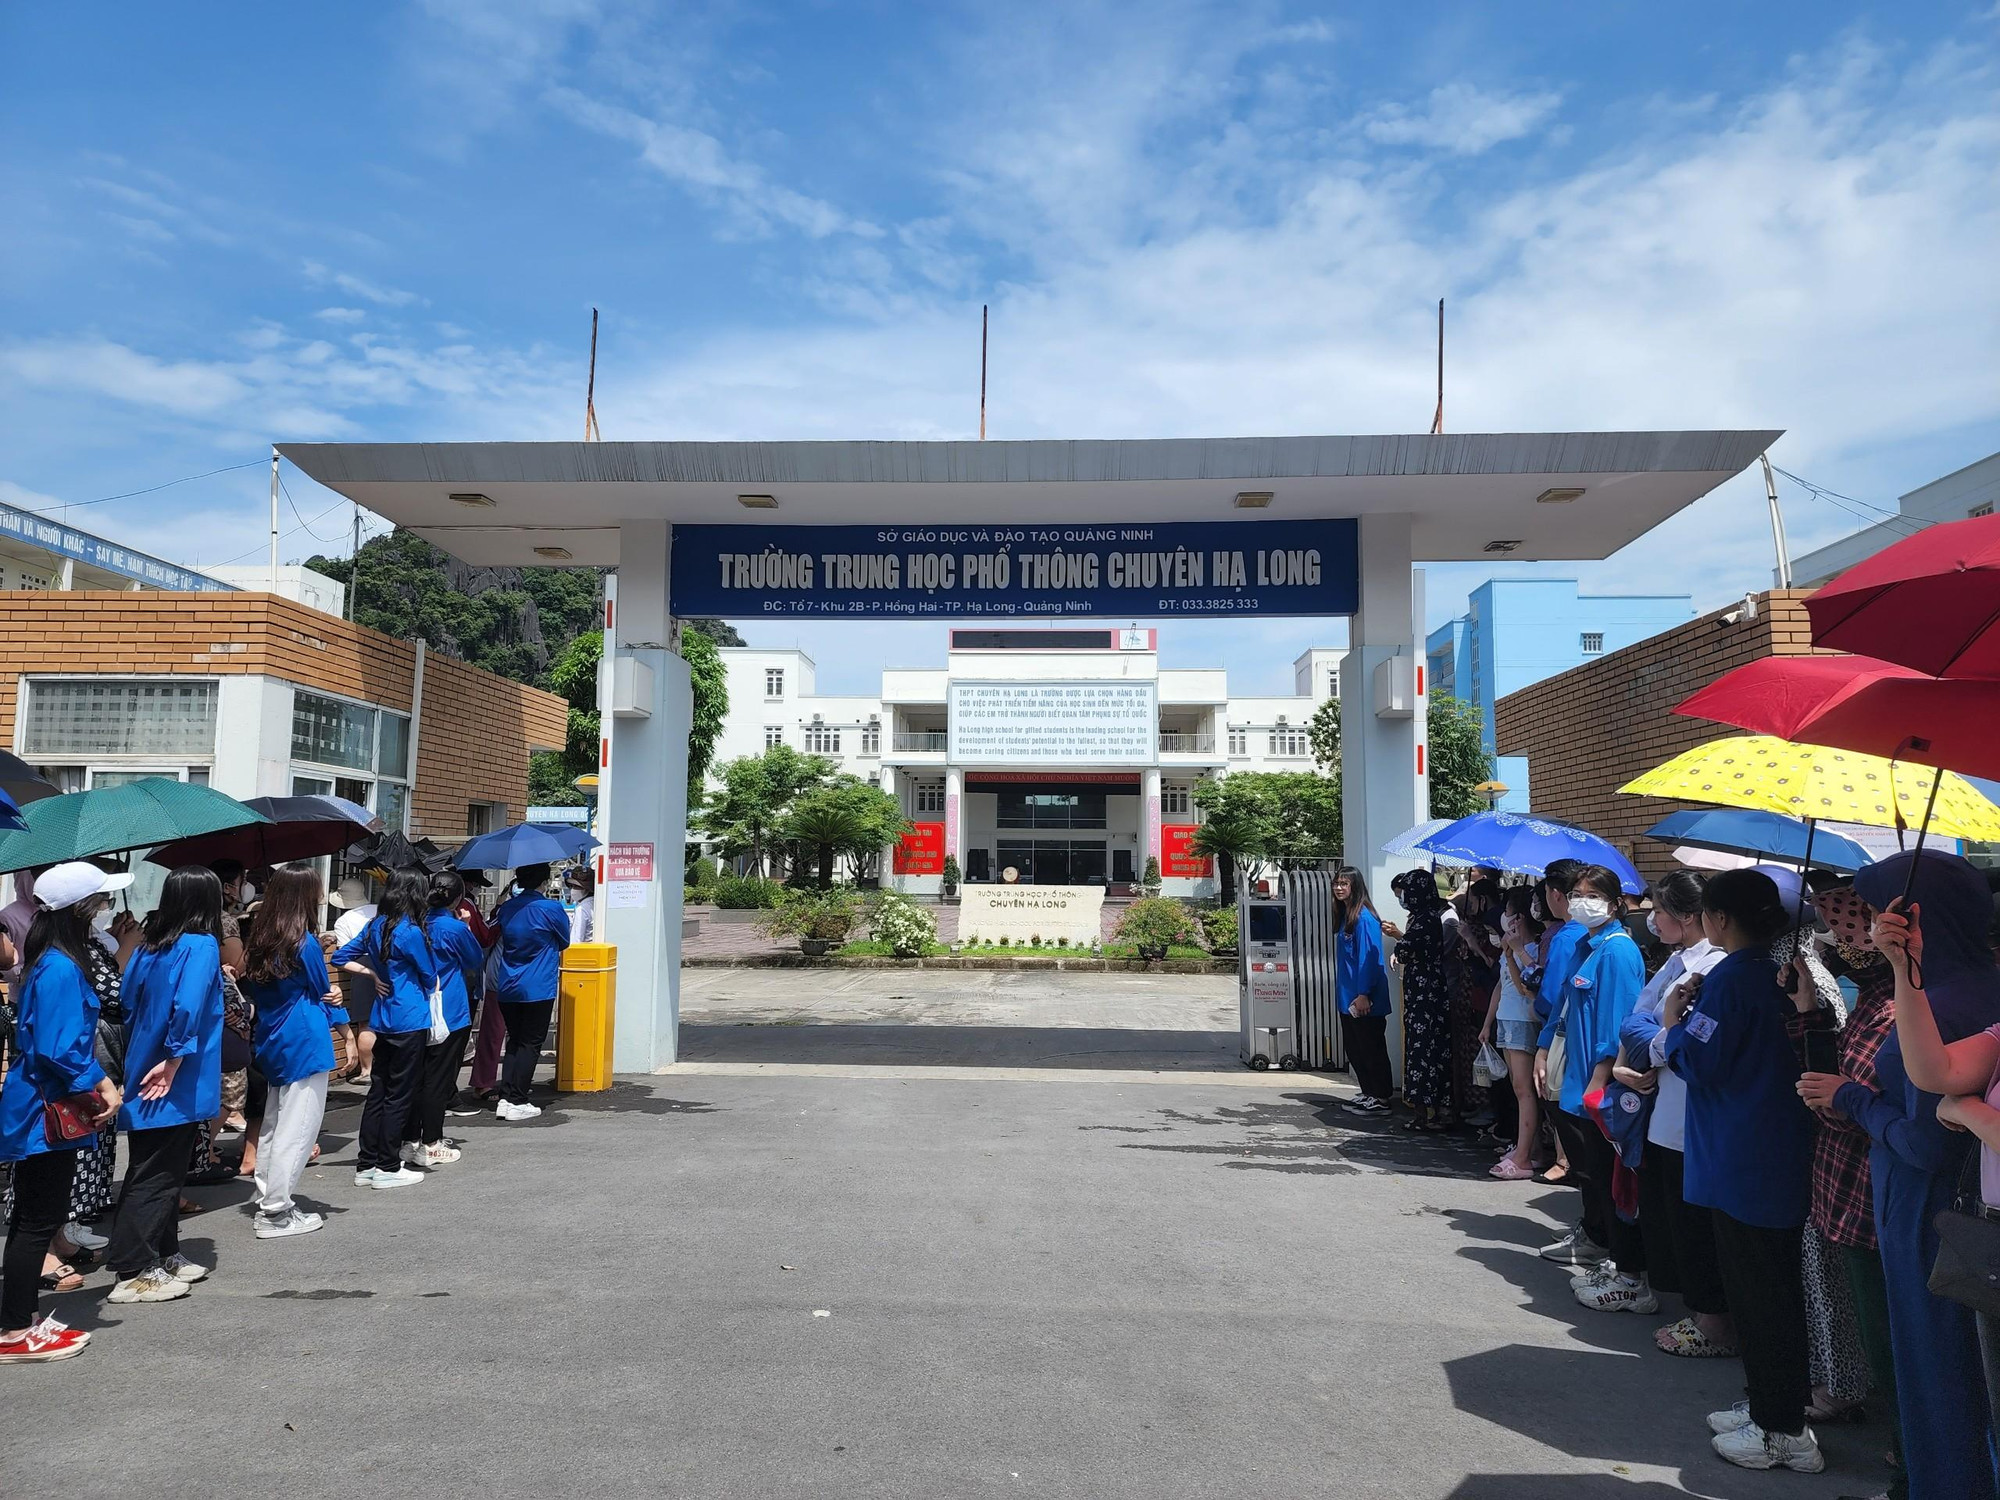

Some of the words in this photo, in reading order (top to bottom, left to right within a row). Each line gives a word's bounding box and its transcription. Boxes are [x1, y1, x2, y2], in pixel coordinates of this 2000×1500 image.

[877, 528, 899, 542] SỞ
[902, 528, 936, 542] GIÁO
[940, 531, 968, 545] DỤC
[971, 528, 990, 542] VÀ
[994, 528, 1025, 542] ĐÀO
[1029, 530, 1060, 545] TẠO
[1064, 527, 1117, 542] QUẢNG
[1121, 530, 1153, 541] NINH
[23, 518, 34, 537] VÀ
[36, 524, 61, 547] NGƯỜI
[63, 533, 85, 554] KHÁC
[95, 545, 111, 563] SAY
[127, 556, 143, 575] HAM
[145, 562, 164, 582] THÍCH
[718, 543, 814, 590] TRƯỜNG
[821, 553, 900, 590] TRUNG
[907, 553, 956, 594] HỌC
[963, 543, 1011, 589] PHỔ
[1018, 546, 1100, 590] THÔNG
[1107, 545, 1204, 589] CHUYÊN
[1212, 550, 1247, 592] HẠ
[1256, 549, 1322, 587] LONG
[763, 601, 786, 611] ĐC:
[966, 602, 982, 613] Hạ
[1065, 600, 1092, 611] Ninh
[1158, 599, 1179, 610] ĐT:
[1182, 599, 1234, 610] 033.3825
[1236, 599, 1259, 609] 333
[987, 710, 996, 718] EM
[959, 737, 996, 745] development
[1031, 737, 1057, 745] potential
[984, 748, 1004, 756] caring
[976, 889, 1002, 898] RƯỜNG
[1026, 891, 1042, 899] HỌC
[989, 899, 1025, 908] CHUYÊN
[1027, 900, 1040, 909] HẠ
[1042, 900, 1067, 909] LONG
[1596, 1290, 1638, 1306] BOSTON
